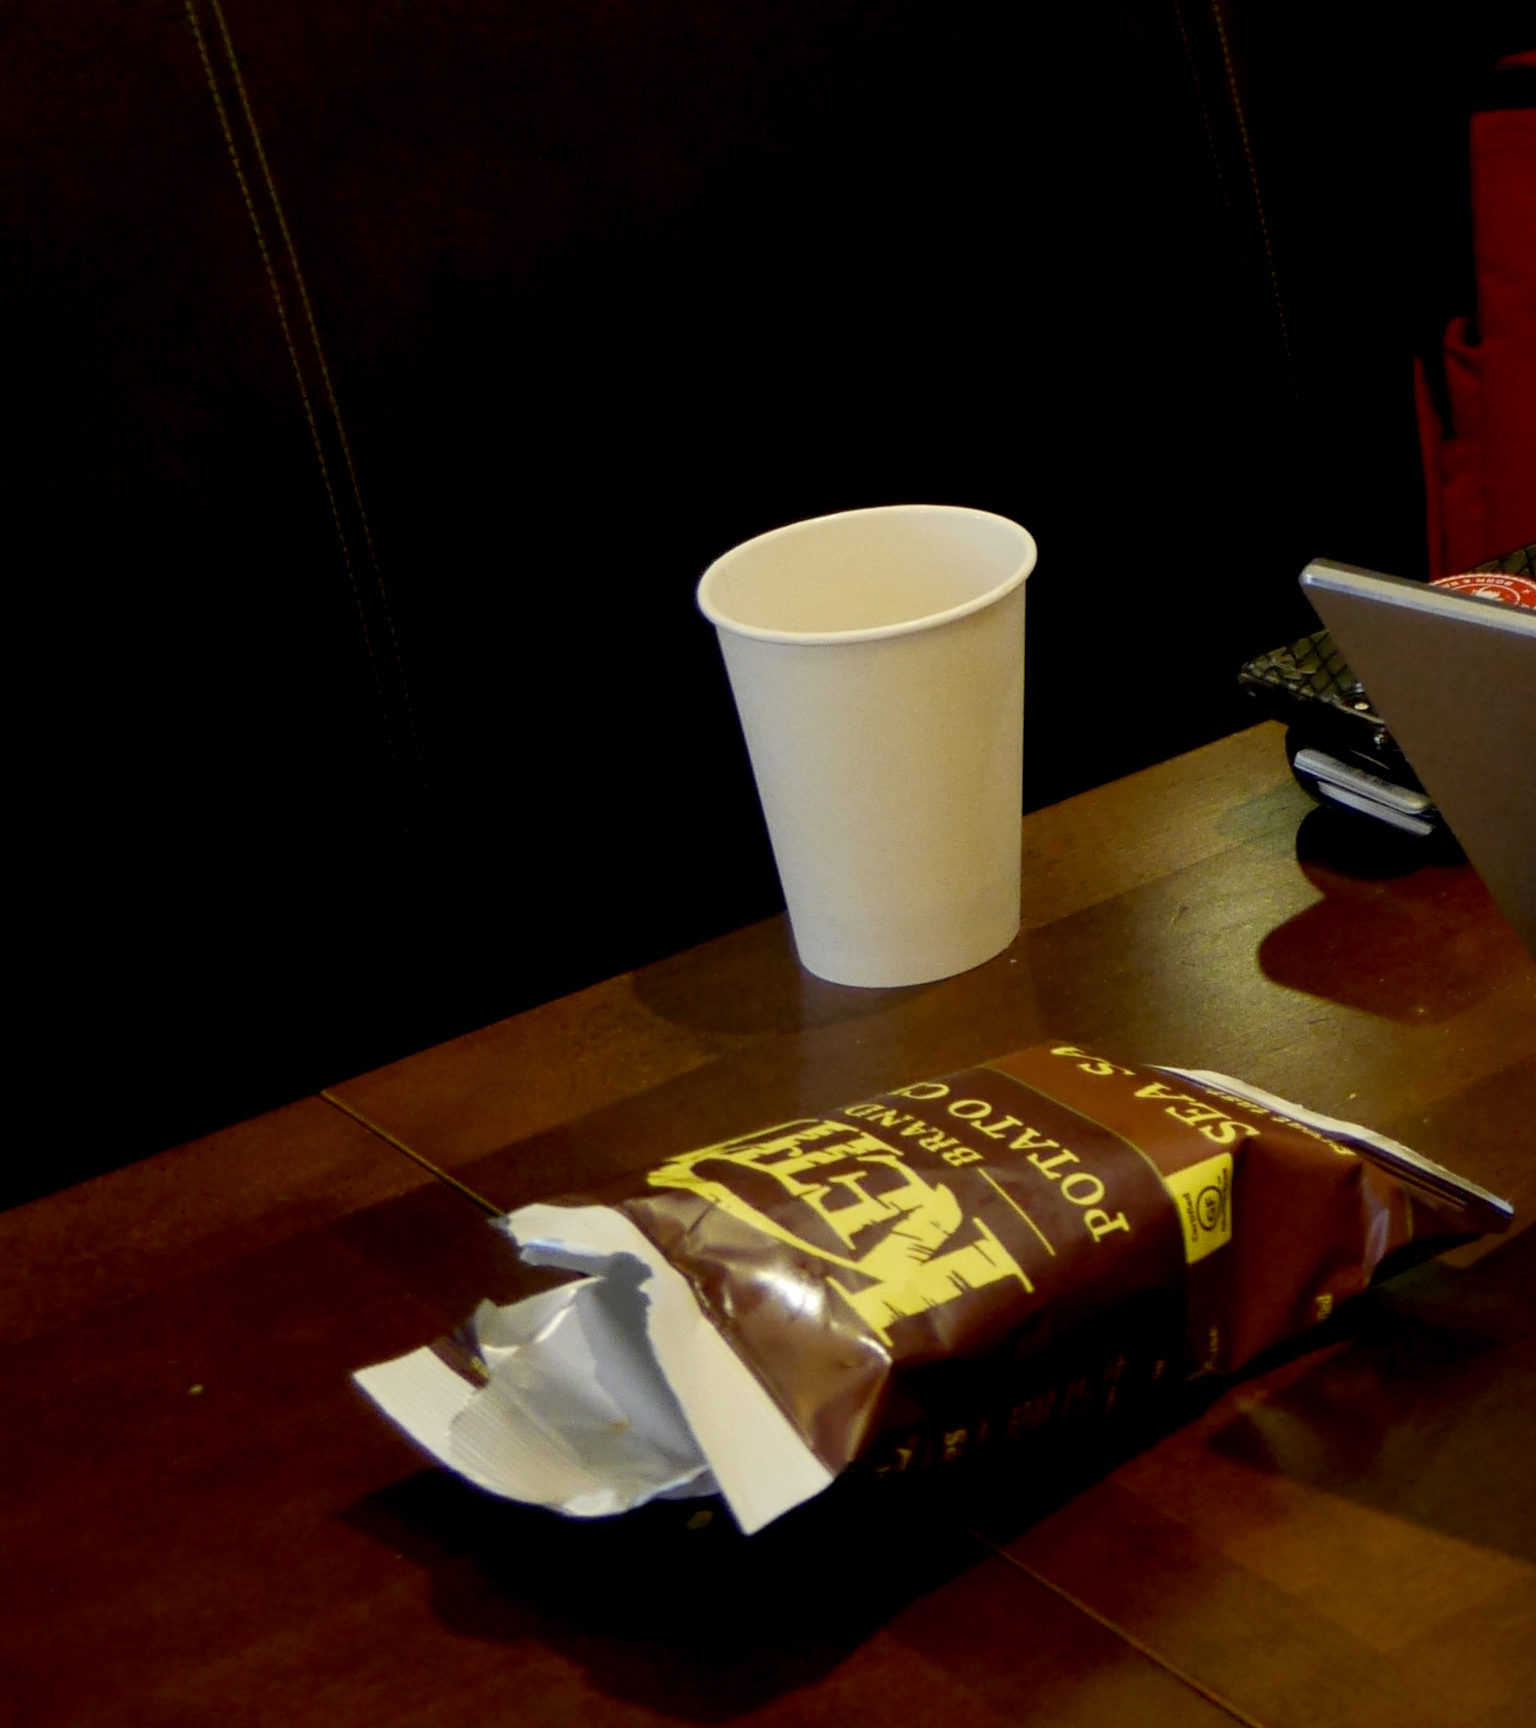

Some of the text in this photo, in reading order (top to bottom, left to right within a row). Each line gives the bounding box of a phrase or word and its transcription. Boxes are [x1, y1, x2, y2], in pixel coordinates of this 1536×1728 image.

[1050, 1041, 1136, 1076] SA
[844, 1103, 984, 1168] BRAND
[1135, 1082, 1260, 1144] SEA
[947, 1098, 1130, 1242] POTATO
